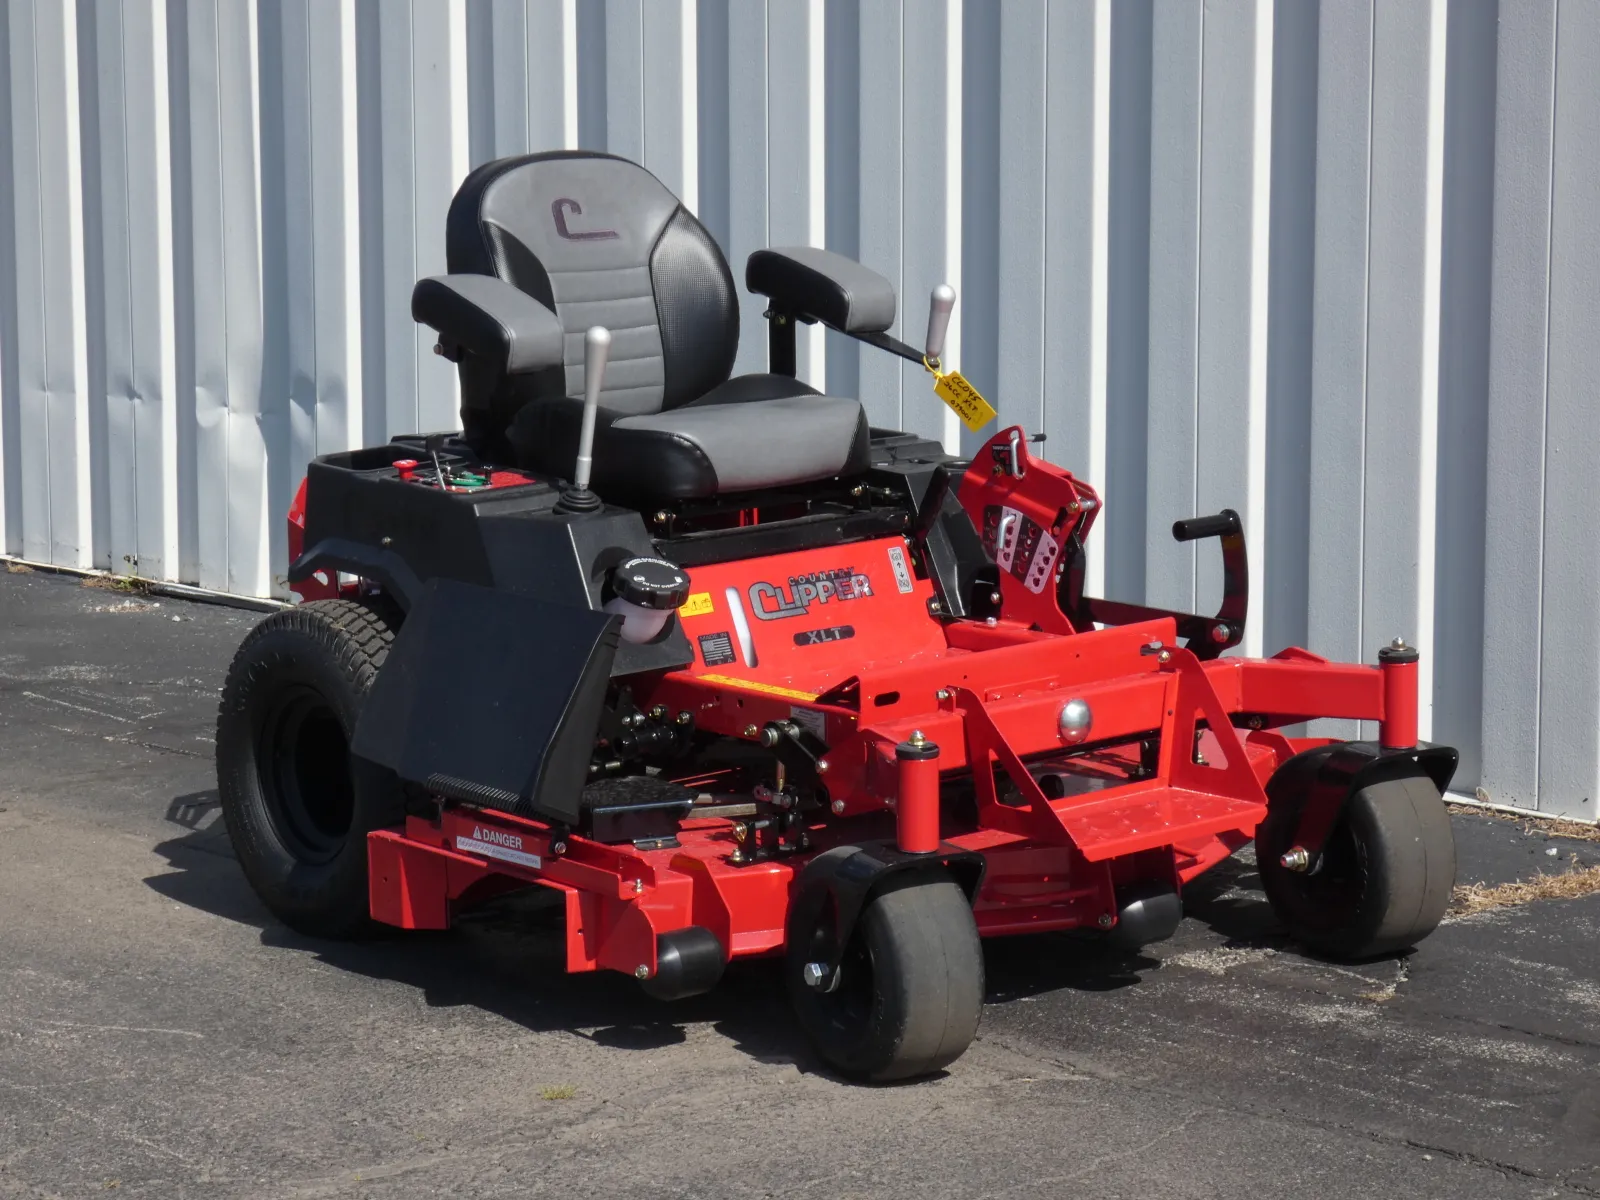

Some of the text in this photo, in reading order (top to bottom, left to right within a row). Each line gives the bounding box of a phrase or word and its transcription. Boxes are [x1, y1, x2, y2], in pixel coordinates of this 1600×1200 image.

[963, 399, 978, 411] XLT
[788, 566, 854, 585] COUNTRY
[748, 574, 874, 621] CLIPPER
[806, 627, 842, 645] XLT
[483, 828, 523, 850] DANGER
